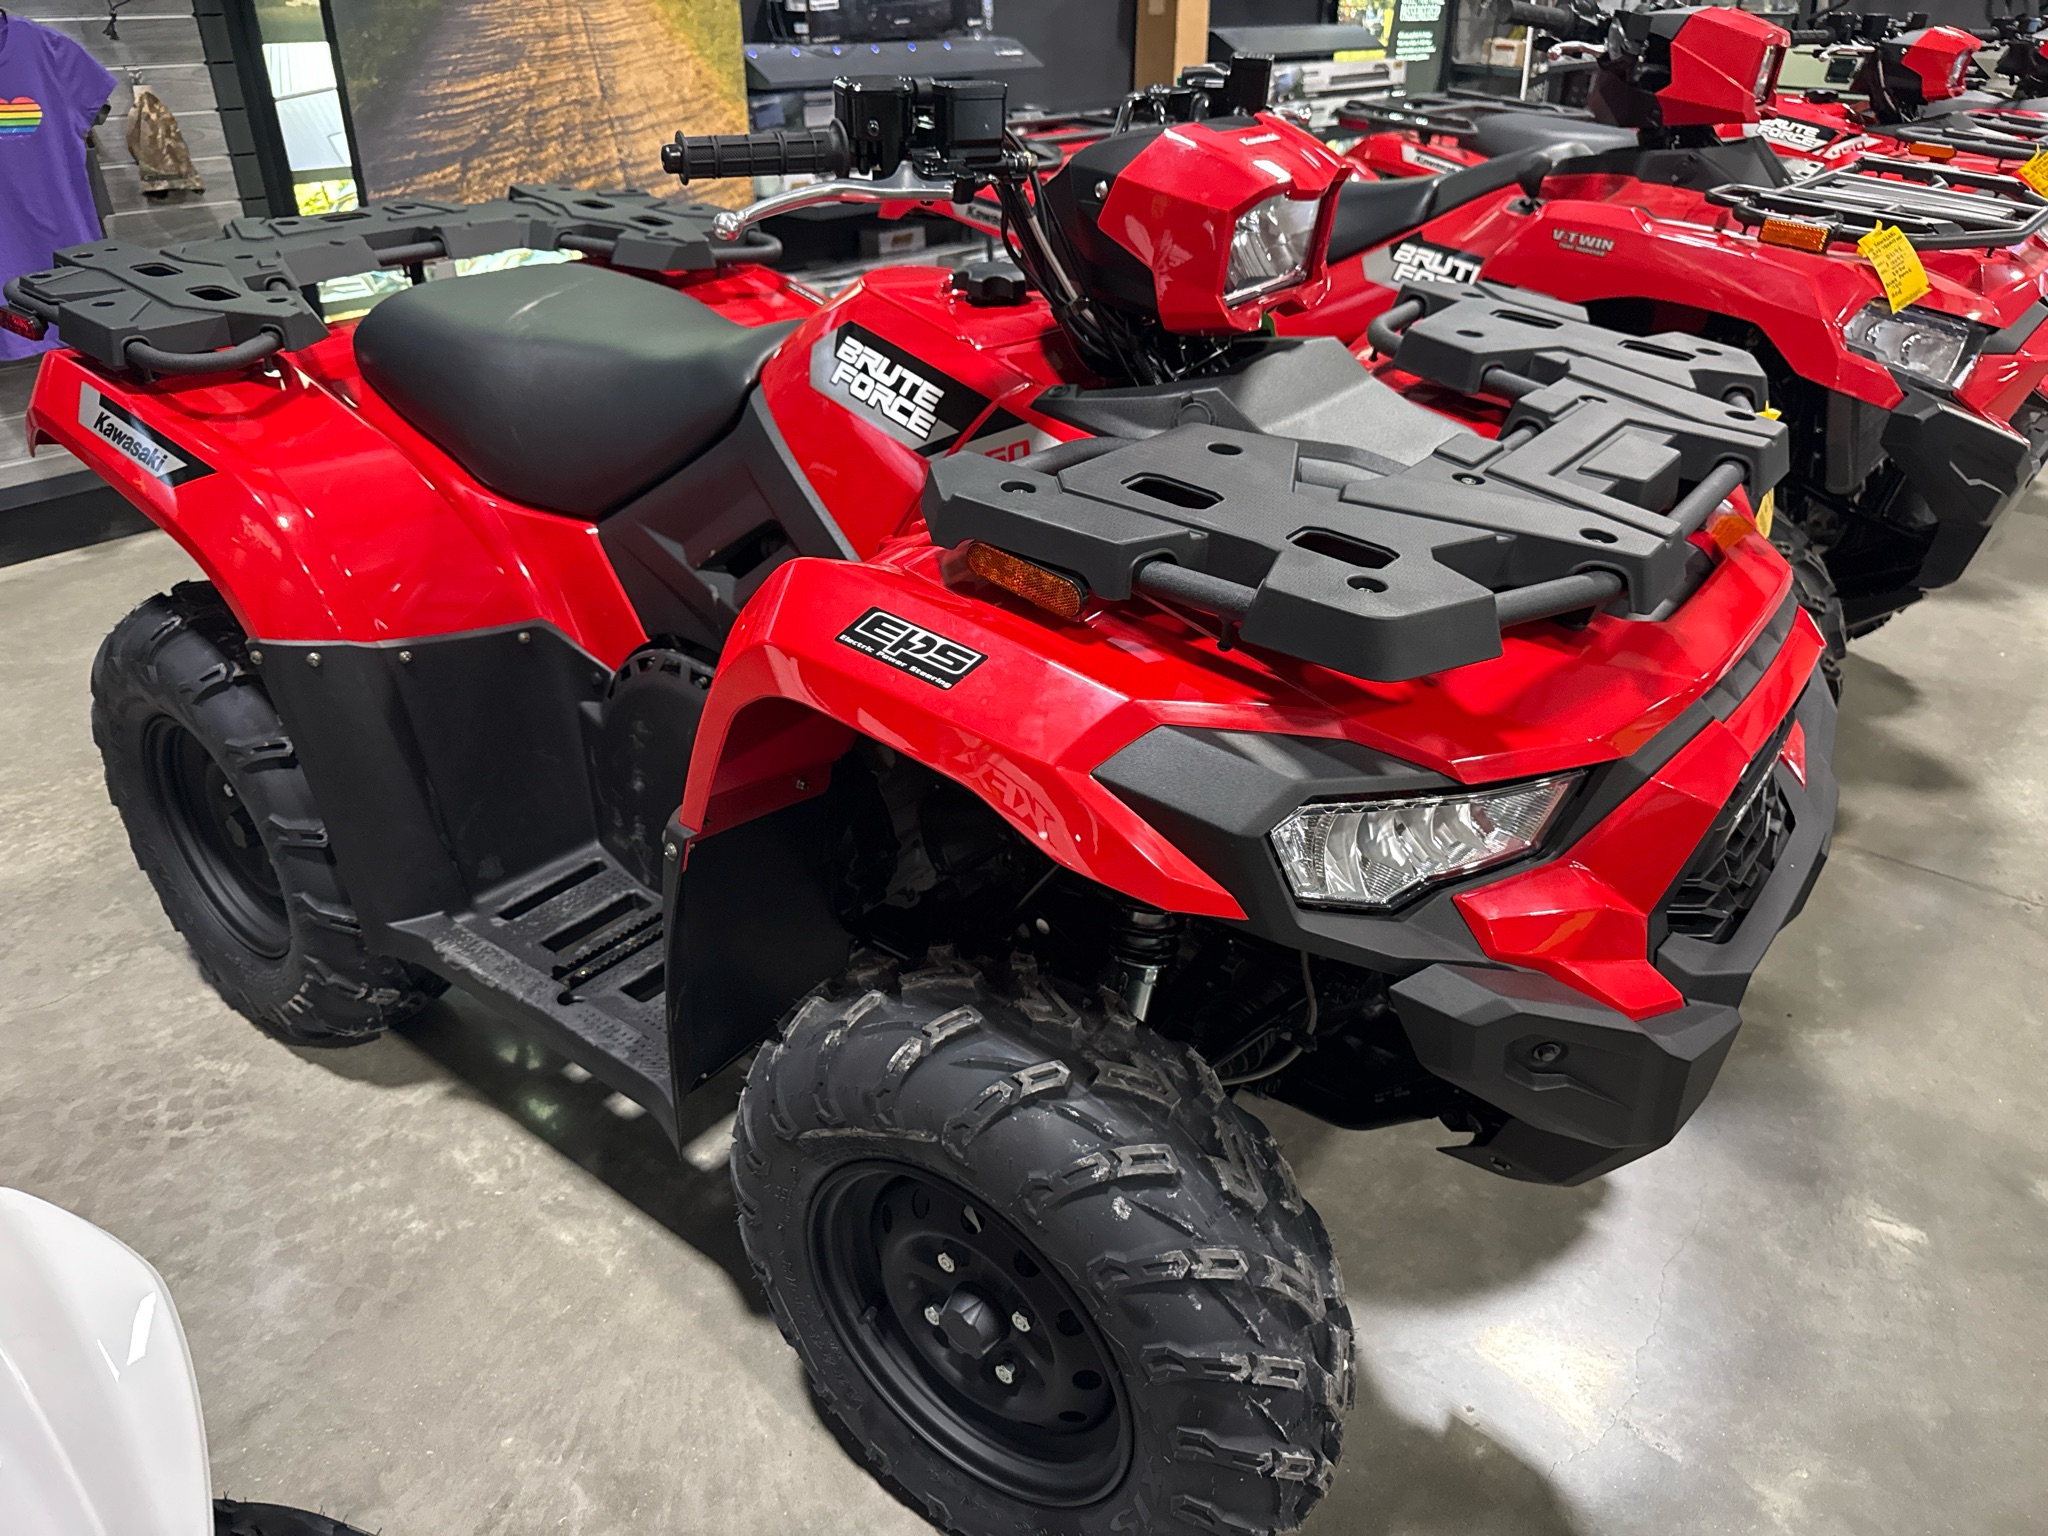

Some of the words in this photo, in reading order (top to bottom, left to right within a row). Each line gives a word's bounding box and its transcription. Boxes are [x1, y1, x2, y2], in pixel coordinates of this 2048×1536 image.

[1757, 125, 1817, 147] FORCE
[830, 360, 938, 440] FORCE
[835, 335, 945, 413] BRUTE
[93, 411, 168, 473] Kawasaki
[838, 633, 875, 653] Electric
[875, 650, 908, 668] Power
[908, 665, 953, 689] Steering
[853, 611, 982, 675] EPS
